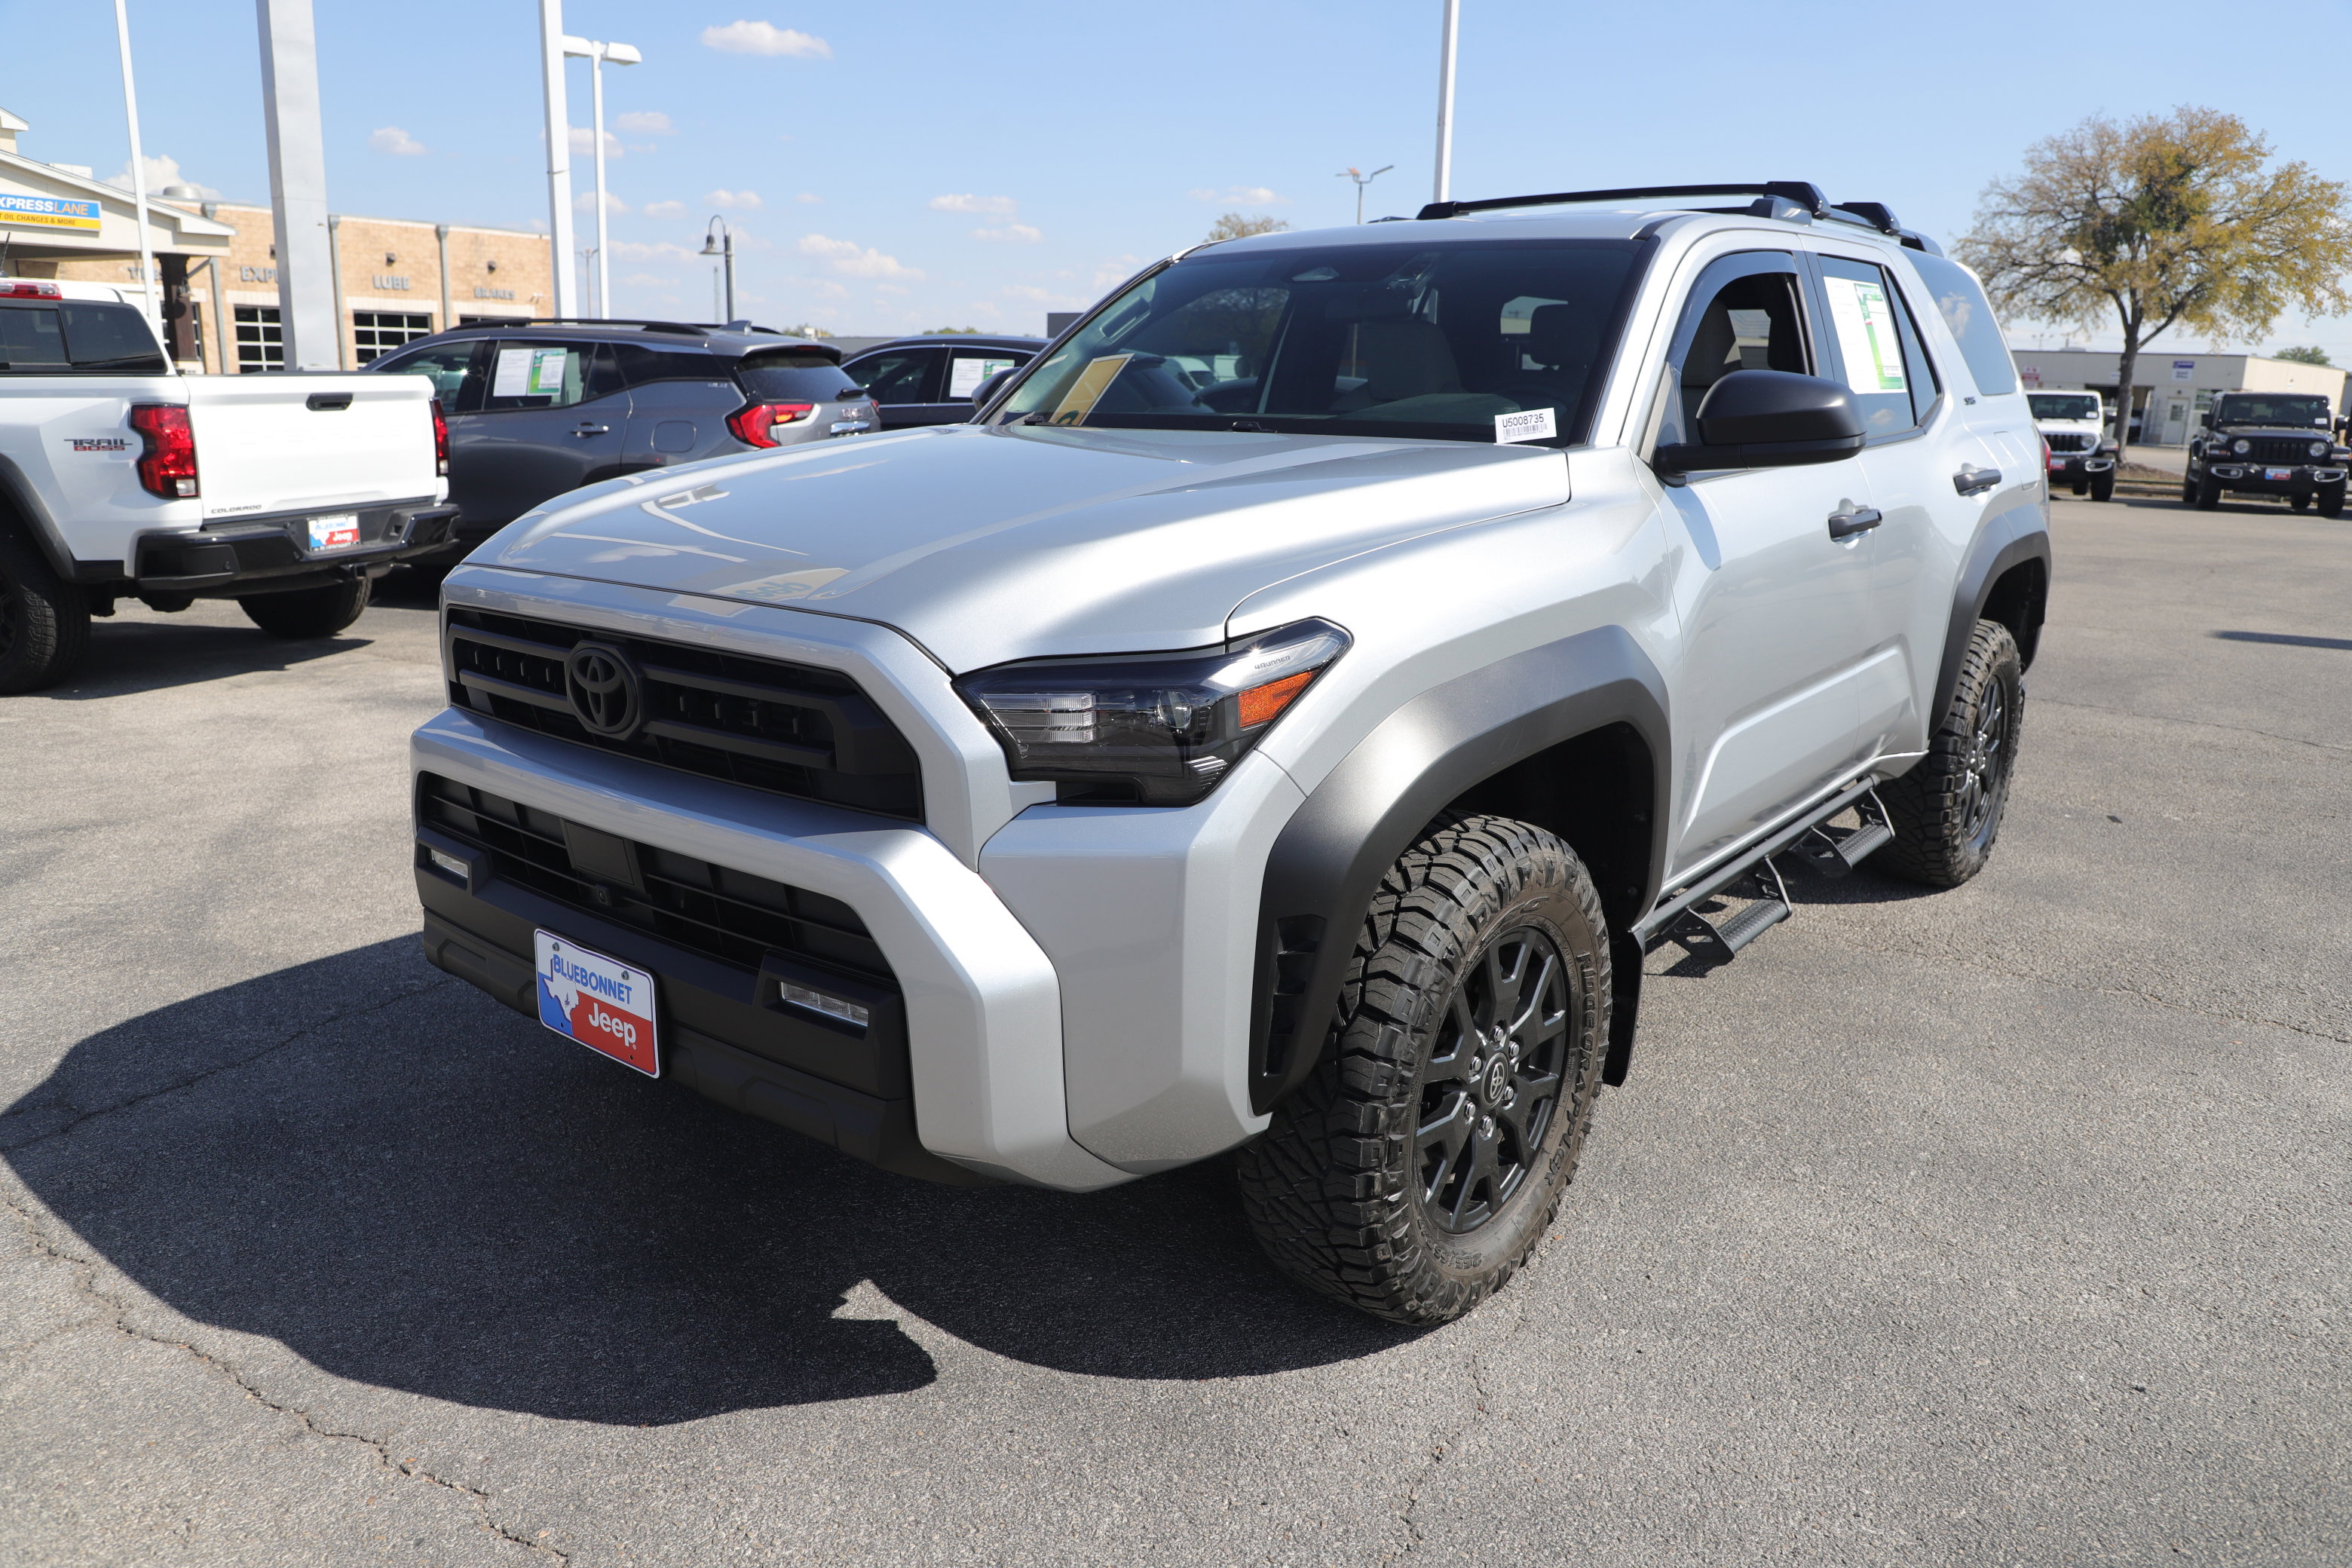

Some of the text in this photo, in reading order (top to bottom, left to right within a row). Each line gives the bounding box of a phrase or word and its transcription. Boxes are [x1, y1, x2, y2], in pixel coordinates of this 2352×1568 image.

[4, 212, 15, 220] OIL
[17, 214, 49, 224] CHANGES
[372, 274, 411, 291] LUBE
[1502, 413, 1545, 428] U5008735
[211, 504, 262, 513] COLORADO
[332, 531, 353, 543] Jeep
[1254, 655, 1291, 669] 4RUNNER
[553, 954, 632, 1005] BLUEBONNET
[588, 1002, 637, 1048] Jeep
